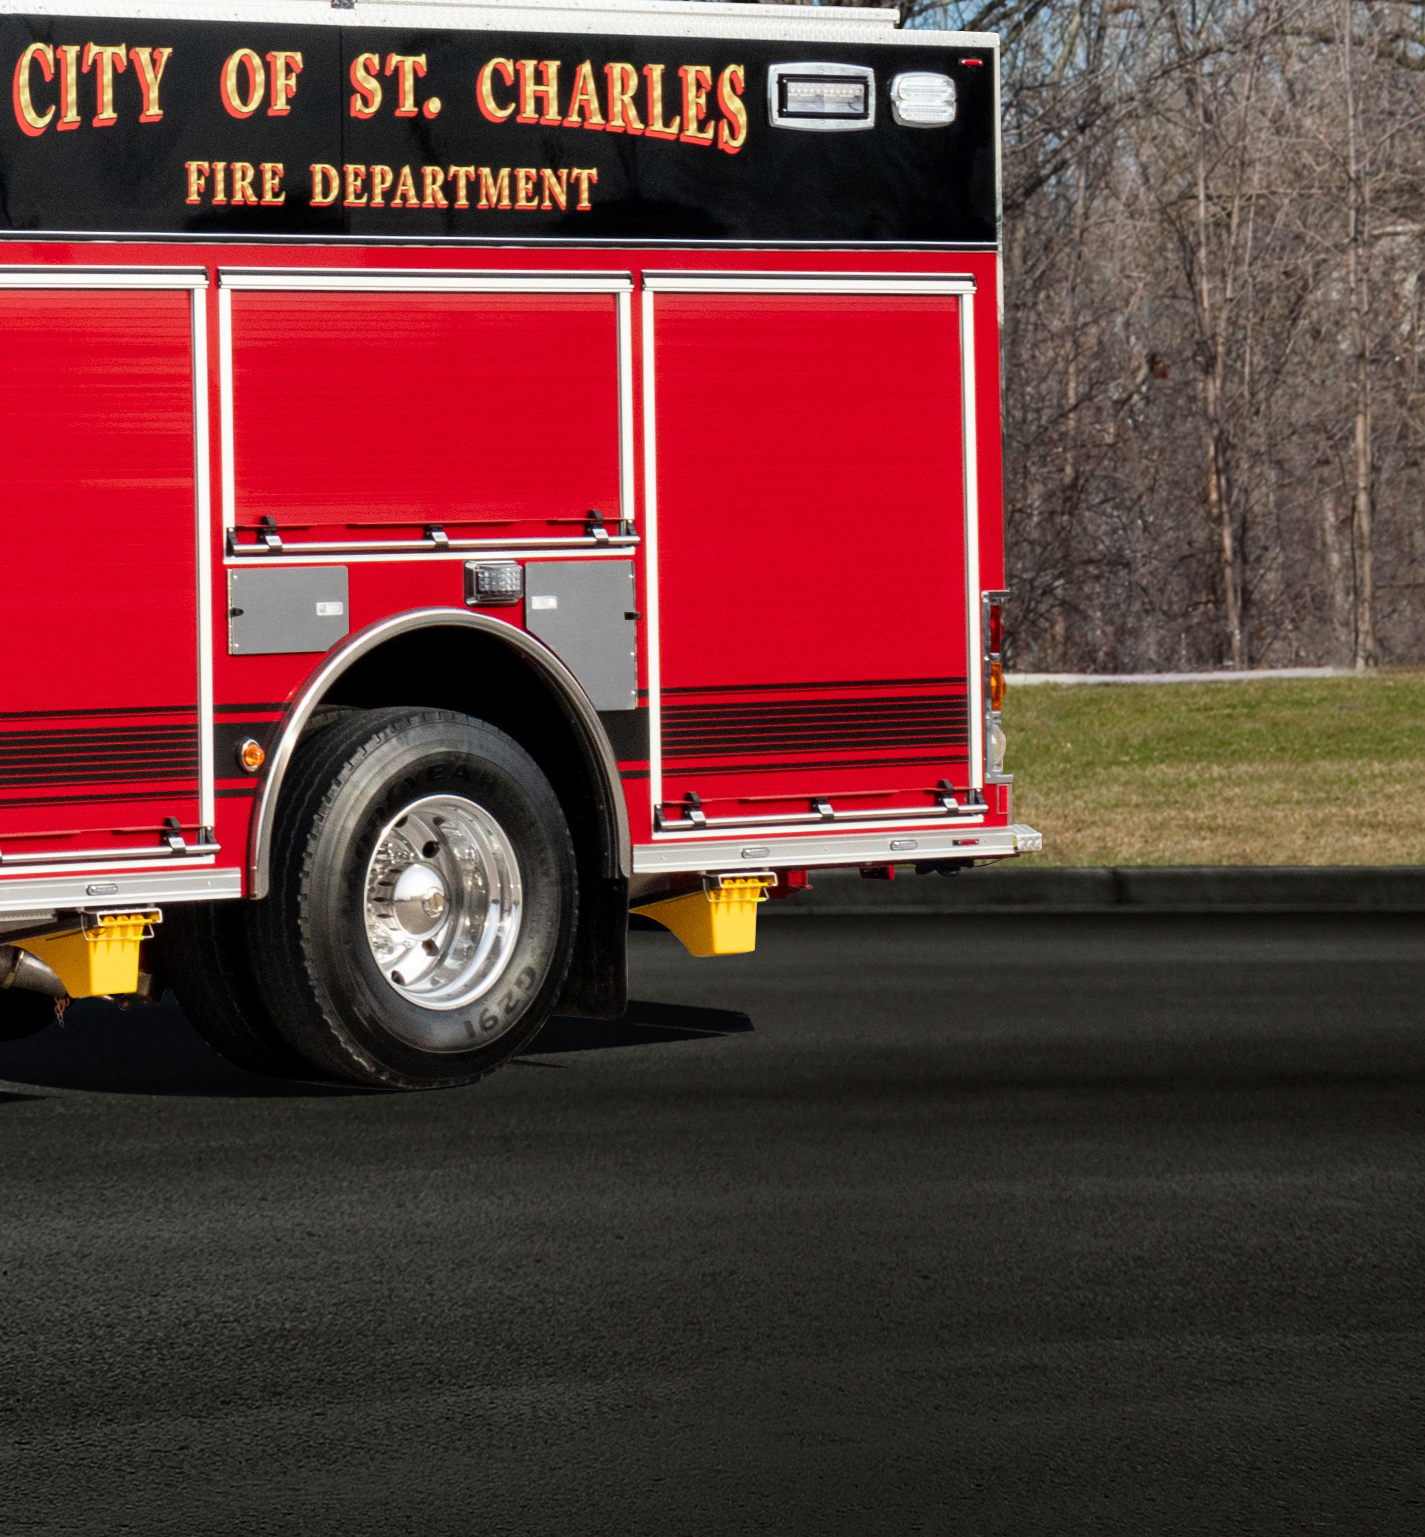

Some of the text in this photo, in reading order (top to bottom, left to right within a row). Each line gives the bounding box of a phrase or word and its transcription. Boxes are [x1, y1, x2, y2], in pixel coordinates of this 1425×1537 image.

[12, 41, 748, 155] CITY OF ST. CHARLES
[185, 161, 598, 211] FIRE DEPARTMENT
